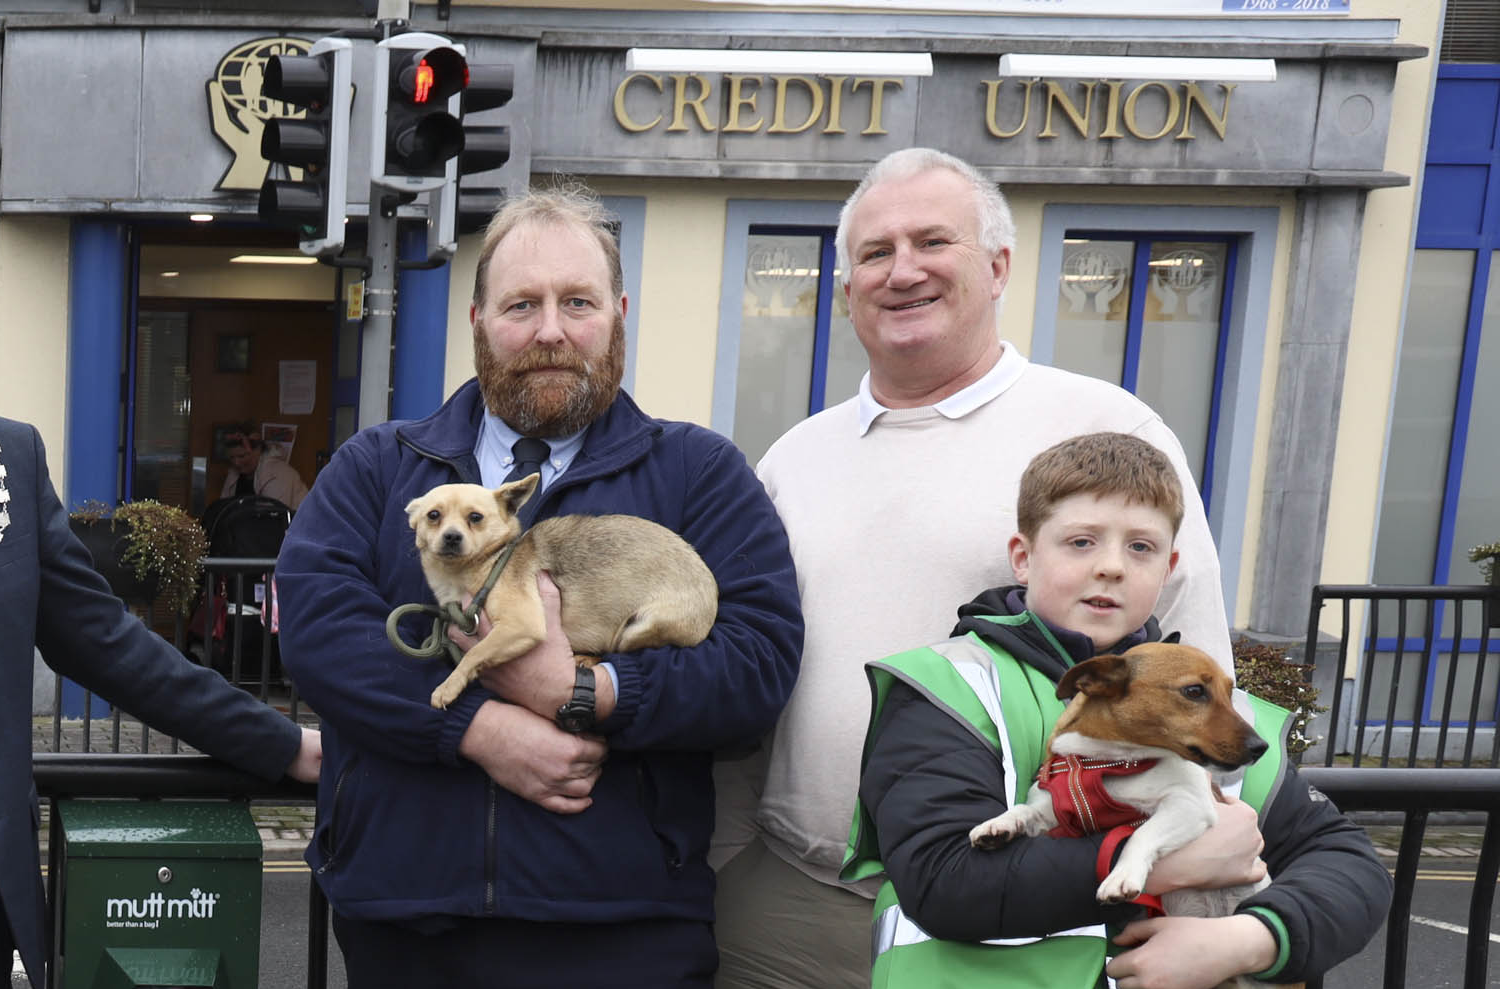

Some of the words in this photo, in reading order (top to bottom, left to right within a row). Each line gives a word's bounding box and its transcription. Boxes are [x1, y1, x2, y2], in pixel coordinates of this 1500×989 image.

[612, 74, 904, 136] CREDIT
[982, 80, 1238, 140] UNION
[106, 892, 165, 918] mutt
[106, 920, 124, 928] better
[125, 920, 138, 928] than
